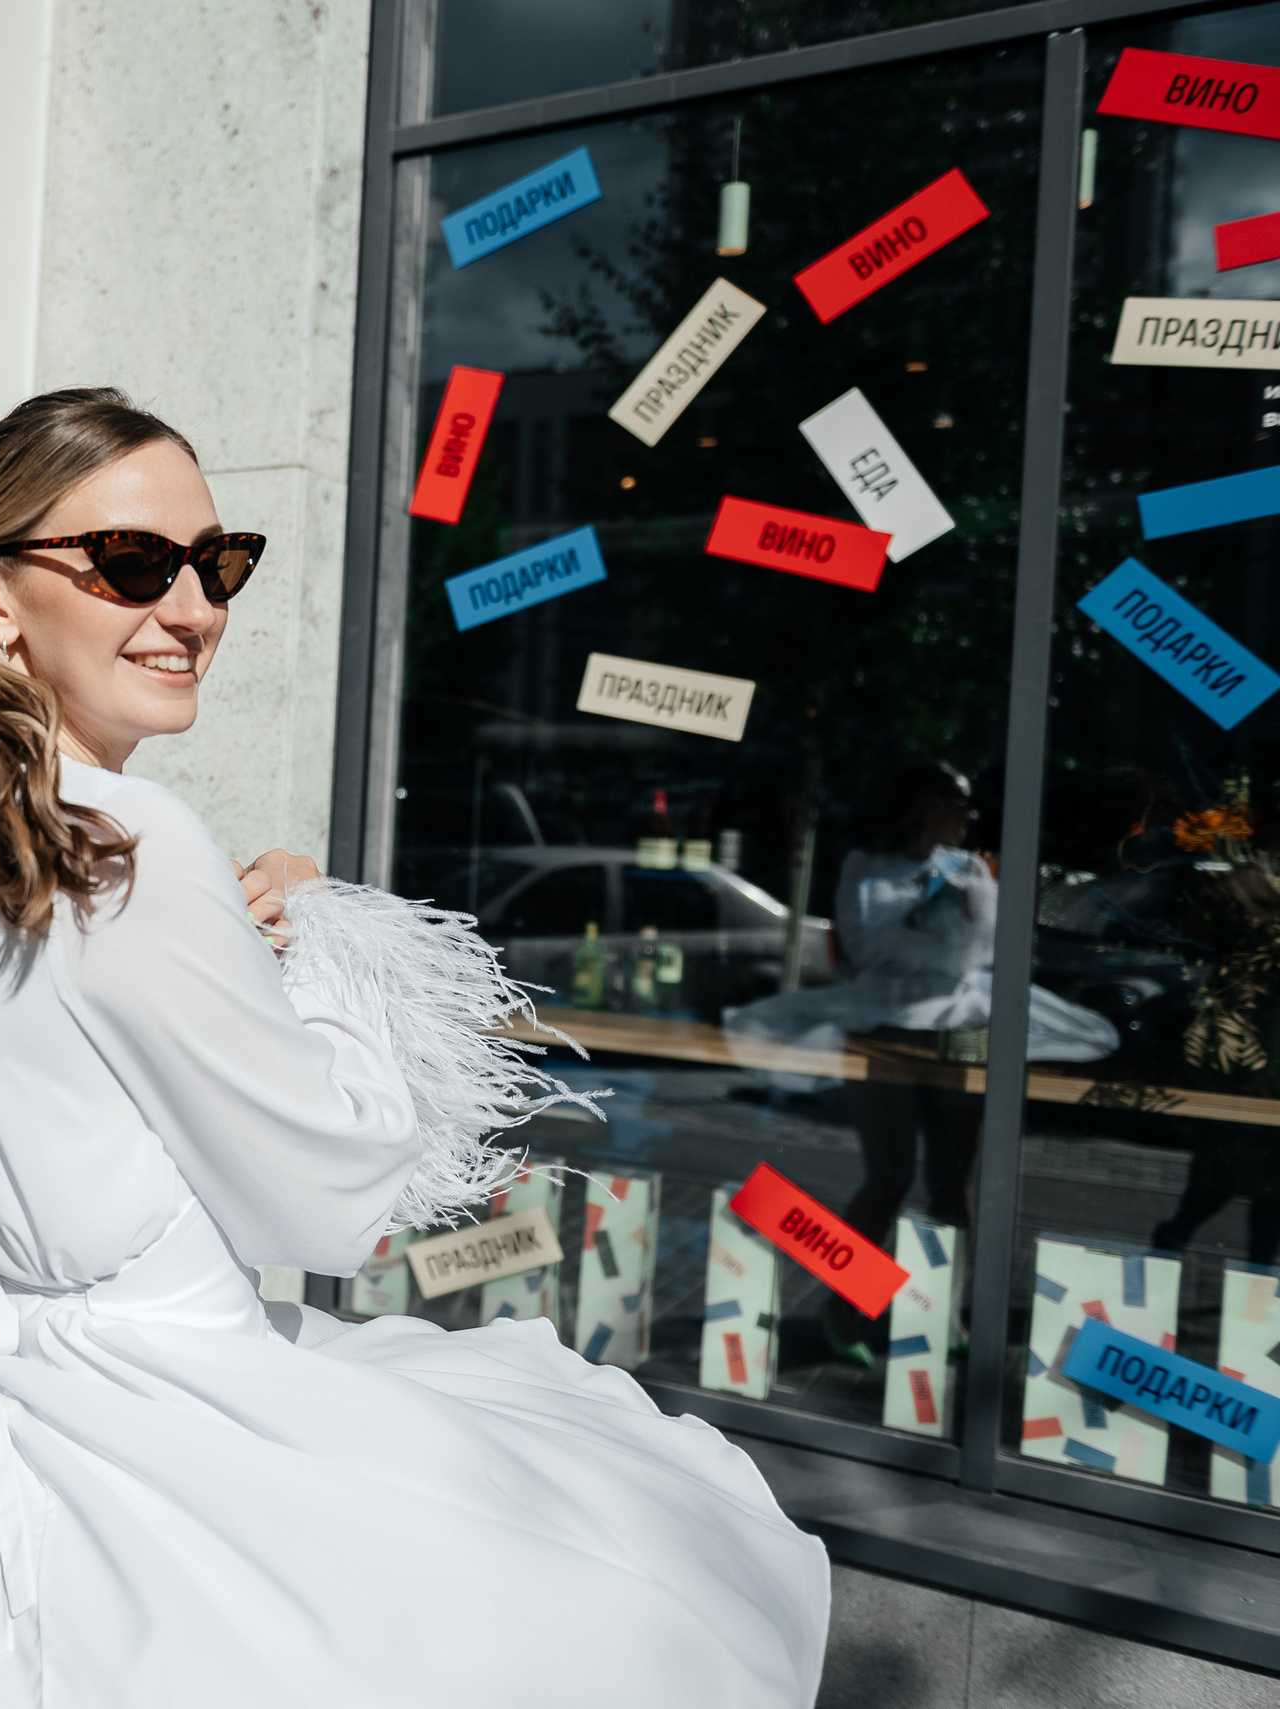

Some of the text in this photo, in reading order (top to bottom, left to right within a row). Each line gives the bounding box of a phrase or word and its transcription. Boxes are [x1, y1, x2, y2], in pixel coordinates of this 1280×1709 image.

[1164, 74, 1259, 114] ВИНО
[464, 172, 576, 246] ПОДАРКИ
[848, 215, 928, 282] ВИНО
[631, 302, 741, 425] ПРАЗДНИК
[436, 411, 476, 478] ВИНО
[849, 446, 899, 503] ЕДА
[758, 520, 837, 565] ВИНО
[468, 547, 581, 612] ПОДАРКИ
[1112, 588, 1248, 700] ПОДАРКИ
[596, 671, 733, 722] ПРАЗДНИК
[424, 1225, 543, 1281] ПРАЗДНИК
[778, 1206, 855, 1272] ВИНО
[908, 1286, 933, 1313] ПИТЬ
[1097, 1344, 1261, 1437] ПОДАРКИ
